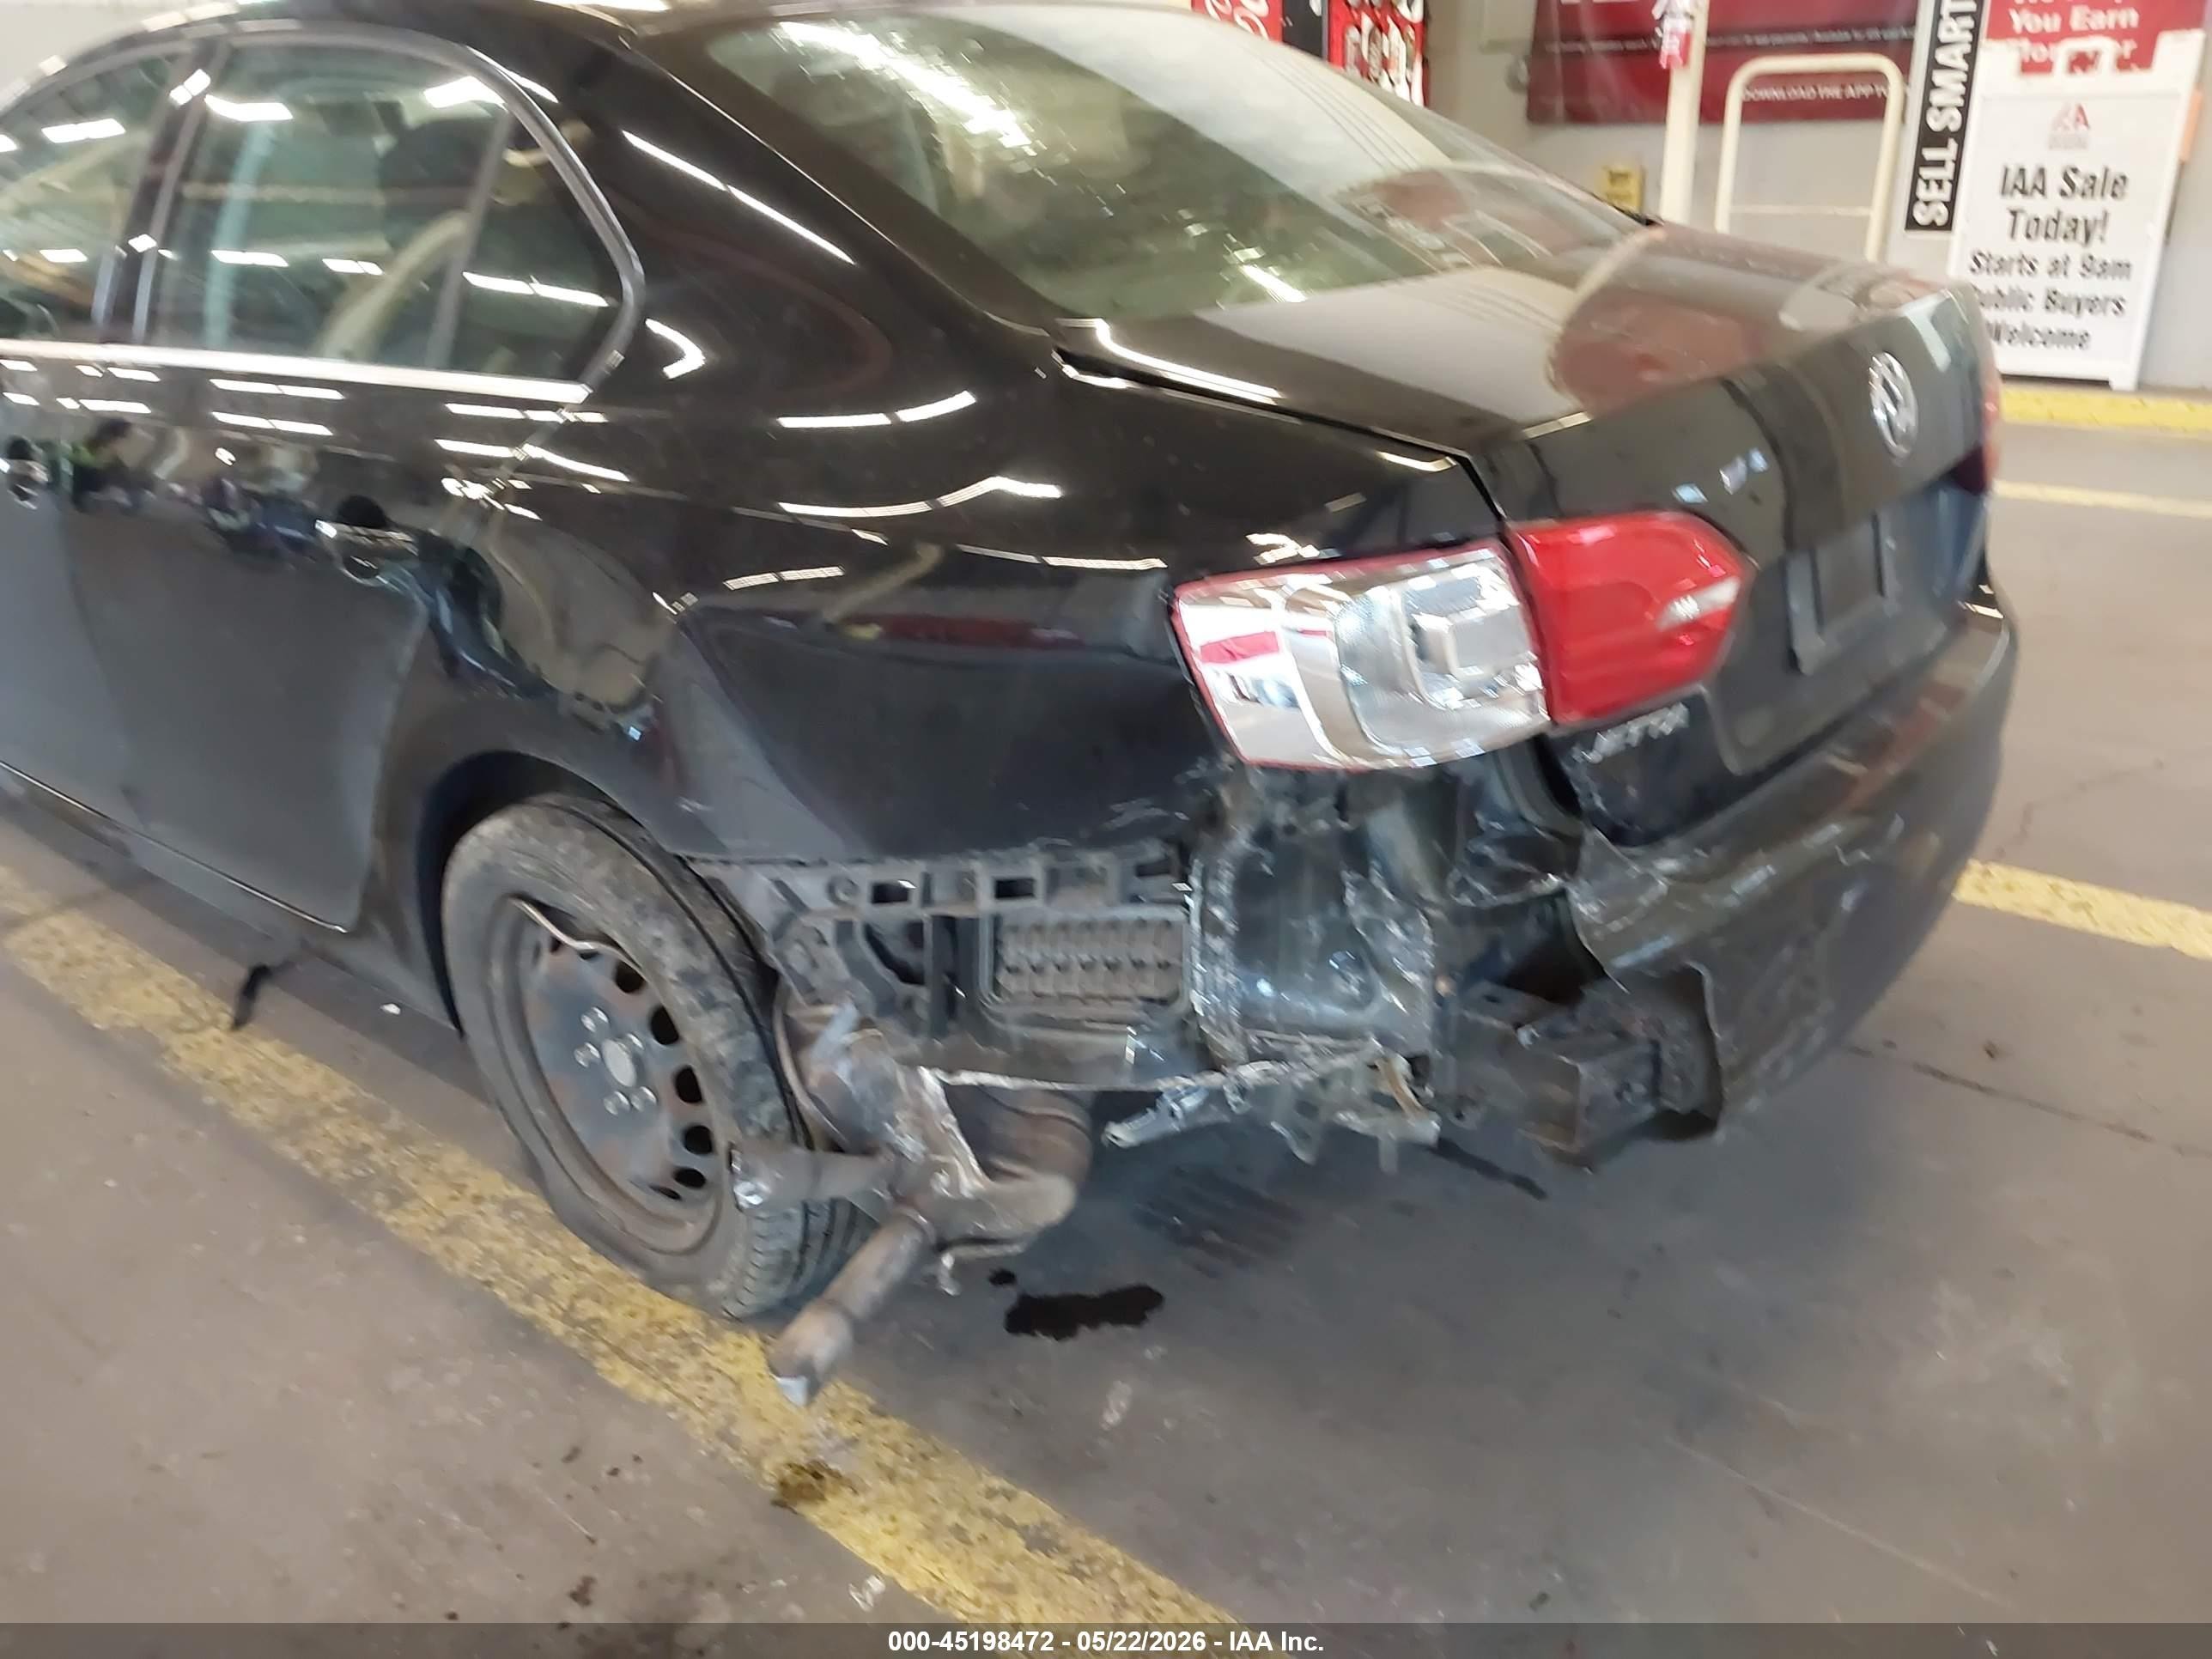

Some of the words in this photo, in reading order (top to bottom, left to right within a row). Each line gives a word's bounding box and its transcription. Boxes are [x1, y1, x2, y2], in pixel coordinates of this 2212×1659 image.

[2008, 8, 2062, 34] You
[2069, 4, 2140, 32] Earn
[1925, 0, 1978, 132] SMART
[1912, 137, 1959, 227] SELL
[2000, 165, 2048, 198] IAA
[2057, 164, 2129, 198] Sale
[2008, 207, 2110, 246] Today!
[1969, 249, 2039, 276] Starts
[2047, 252, 2071, 277] at
[1972, 283, 2035, 313] ublic
[2043, 287, 2127, 319] Buyers
